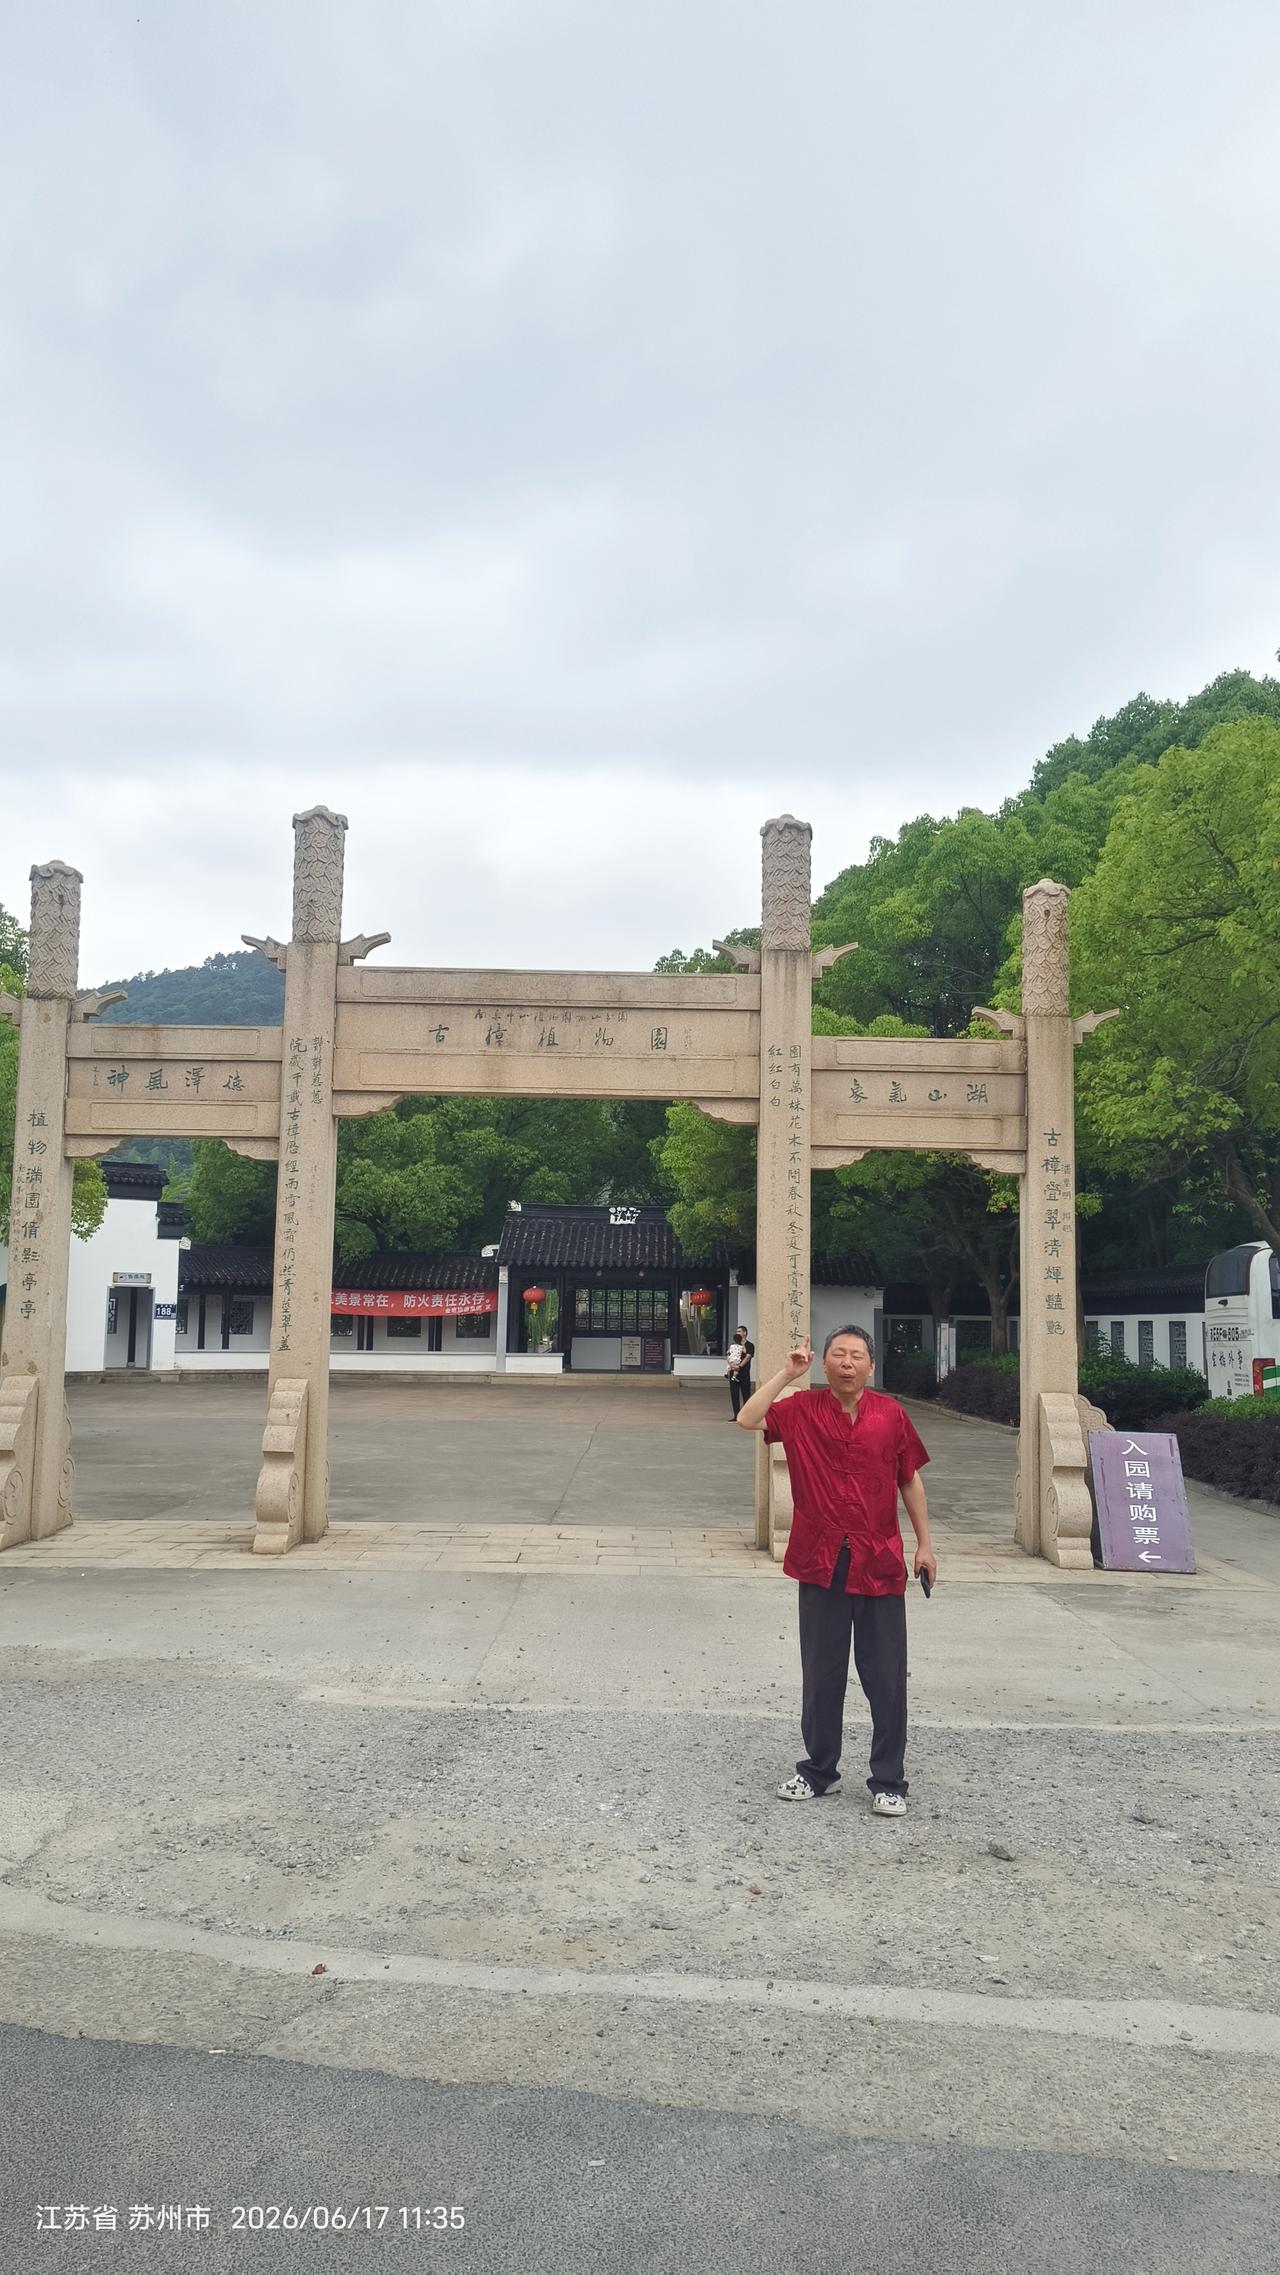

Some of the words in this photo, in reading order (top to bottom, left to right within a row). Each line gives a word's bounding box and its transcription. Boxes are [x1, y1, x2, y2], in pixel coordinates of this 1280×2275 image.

[156, 1307, 172, 1316] 188
[1121, 1439, 1161, 1545] 入园请购票
